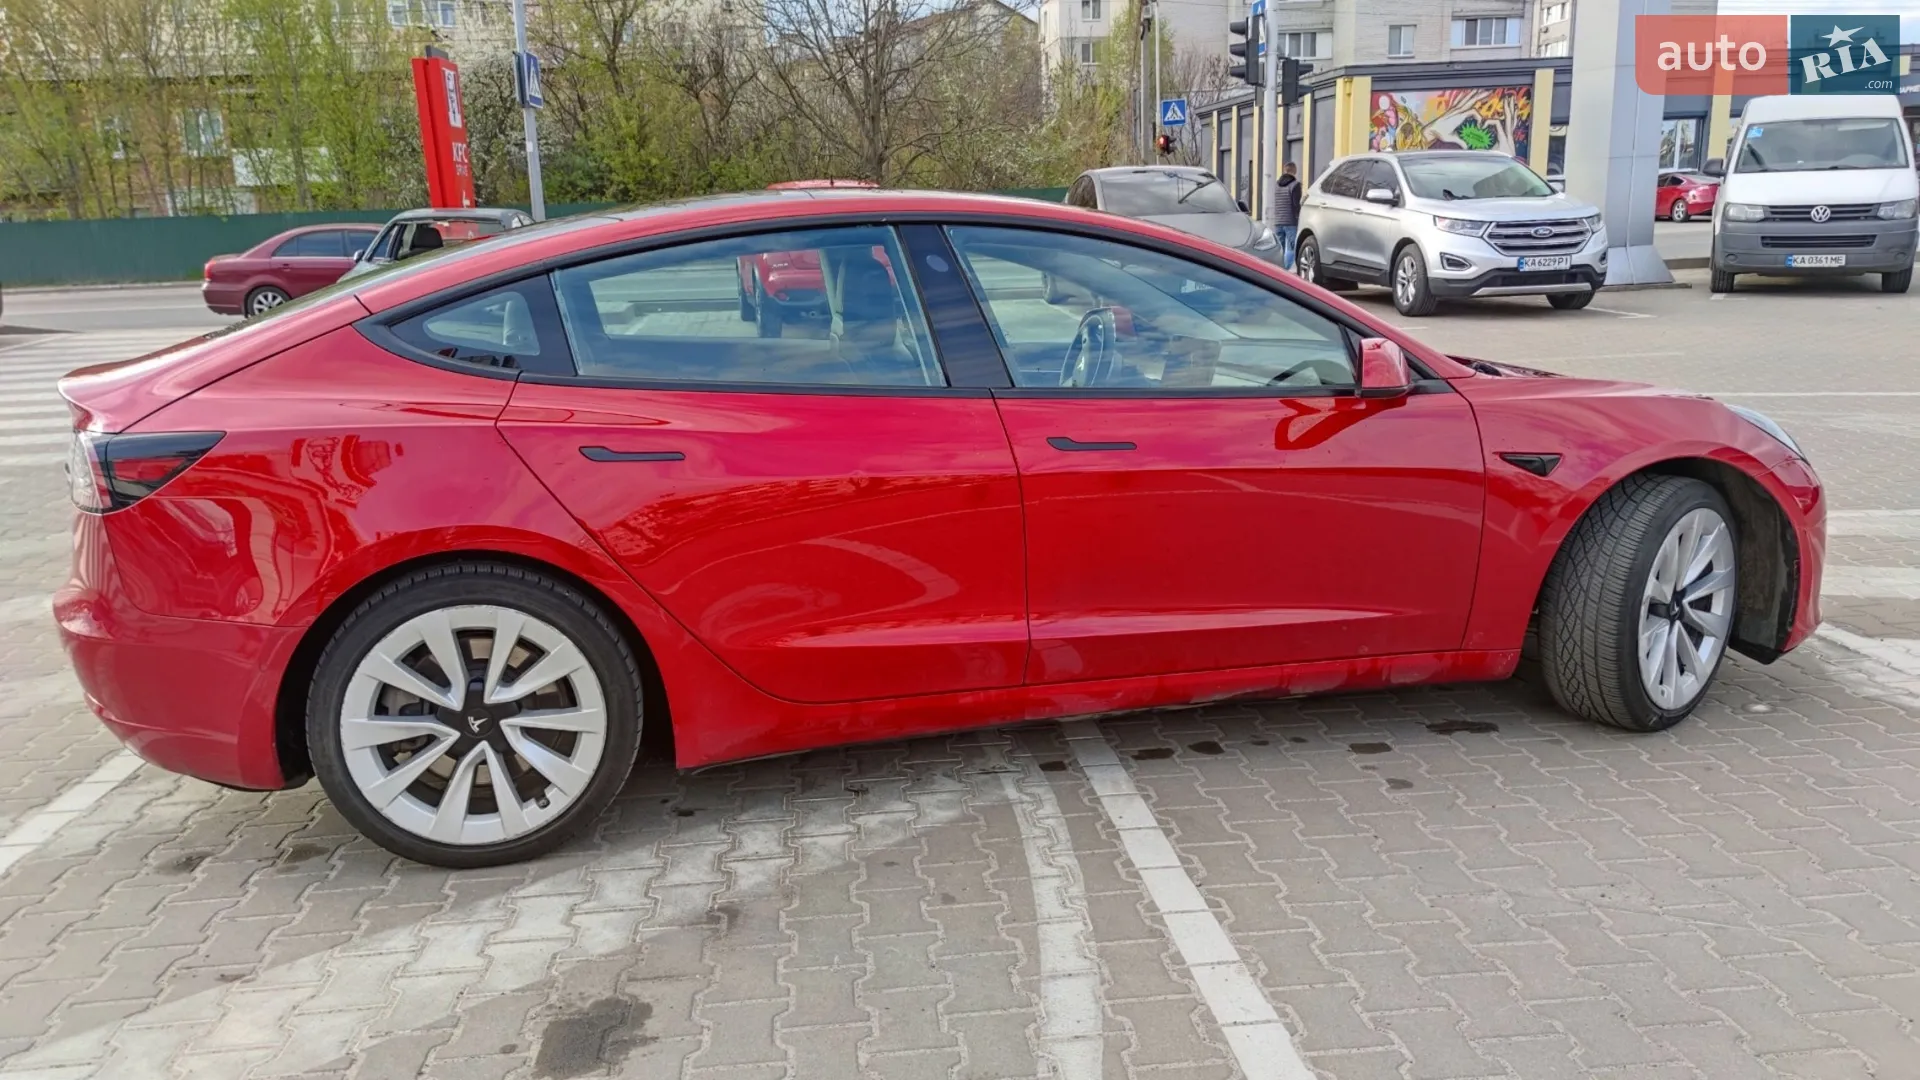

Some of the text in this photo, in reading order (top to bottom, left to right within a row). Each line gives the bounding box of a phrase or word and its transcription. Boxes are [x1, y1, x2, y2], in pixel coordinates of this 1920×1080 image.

[452, 142, 468, 163] KFC
[1525, 258, 1536, 267] KA
[1538, 258, 1556, 267] 6229
[1793, 256, 1806, 264] KA
[1808, 256, 1828, 264] 0361
